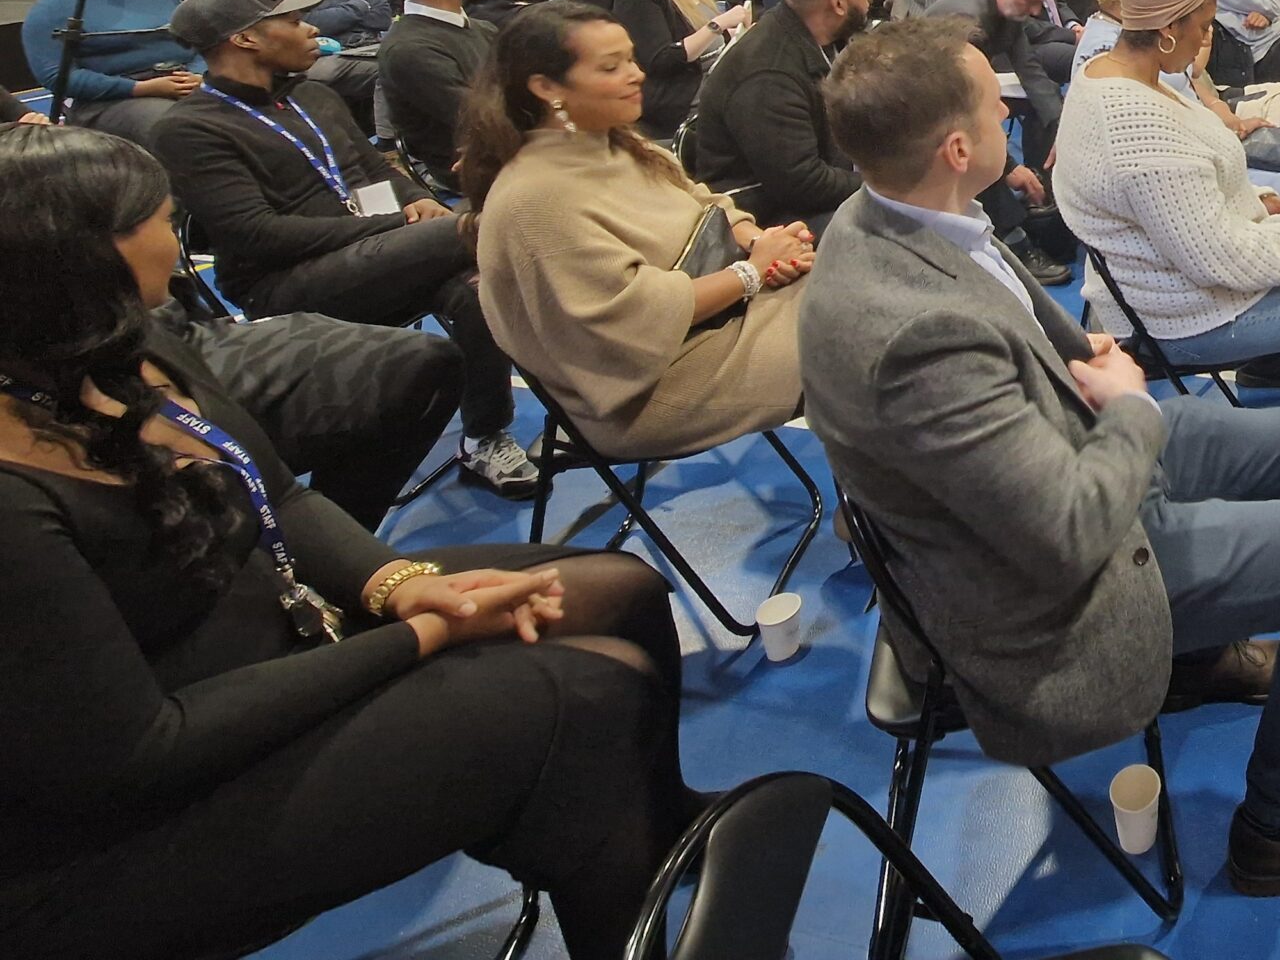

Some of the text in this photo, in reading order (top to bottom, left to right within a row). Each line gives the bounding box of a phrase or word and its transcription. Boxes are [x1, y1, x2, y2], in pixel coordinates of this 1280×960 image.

[176, 413, 211, 435] STAFF
[222, 441, 250, 464] STAFF
[259, 504, 277, 530] STAFF
[272, 541, 288, 564] STAF
